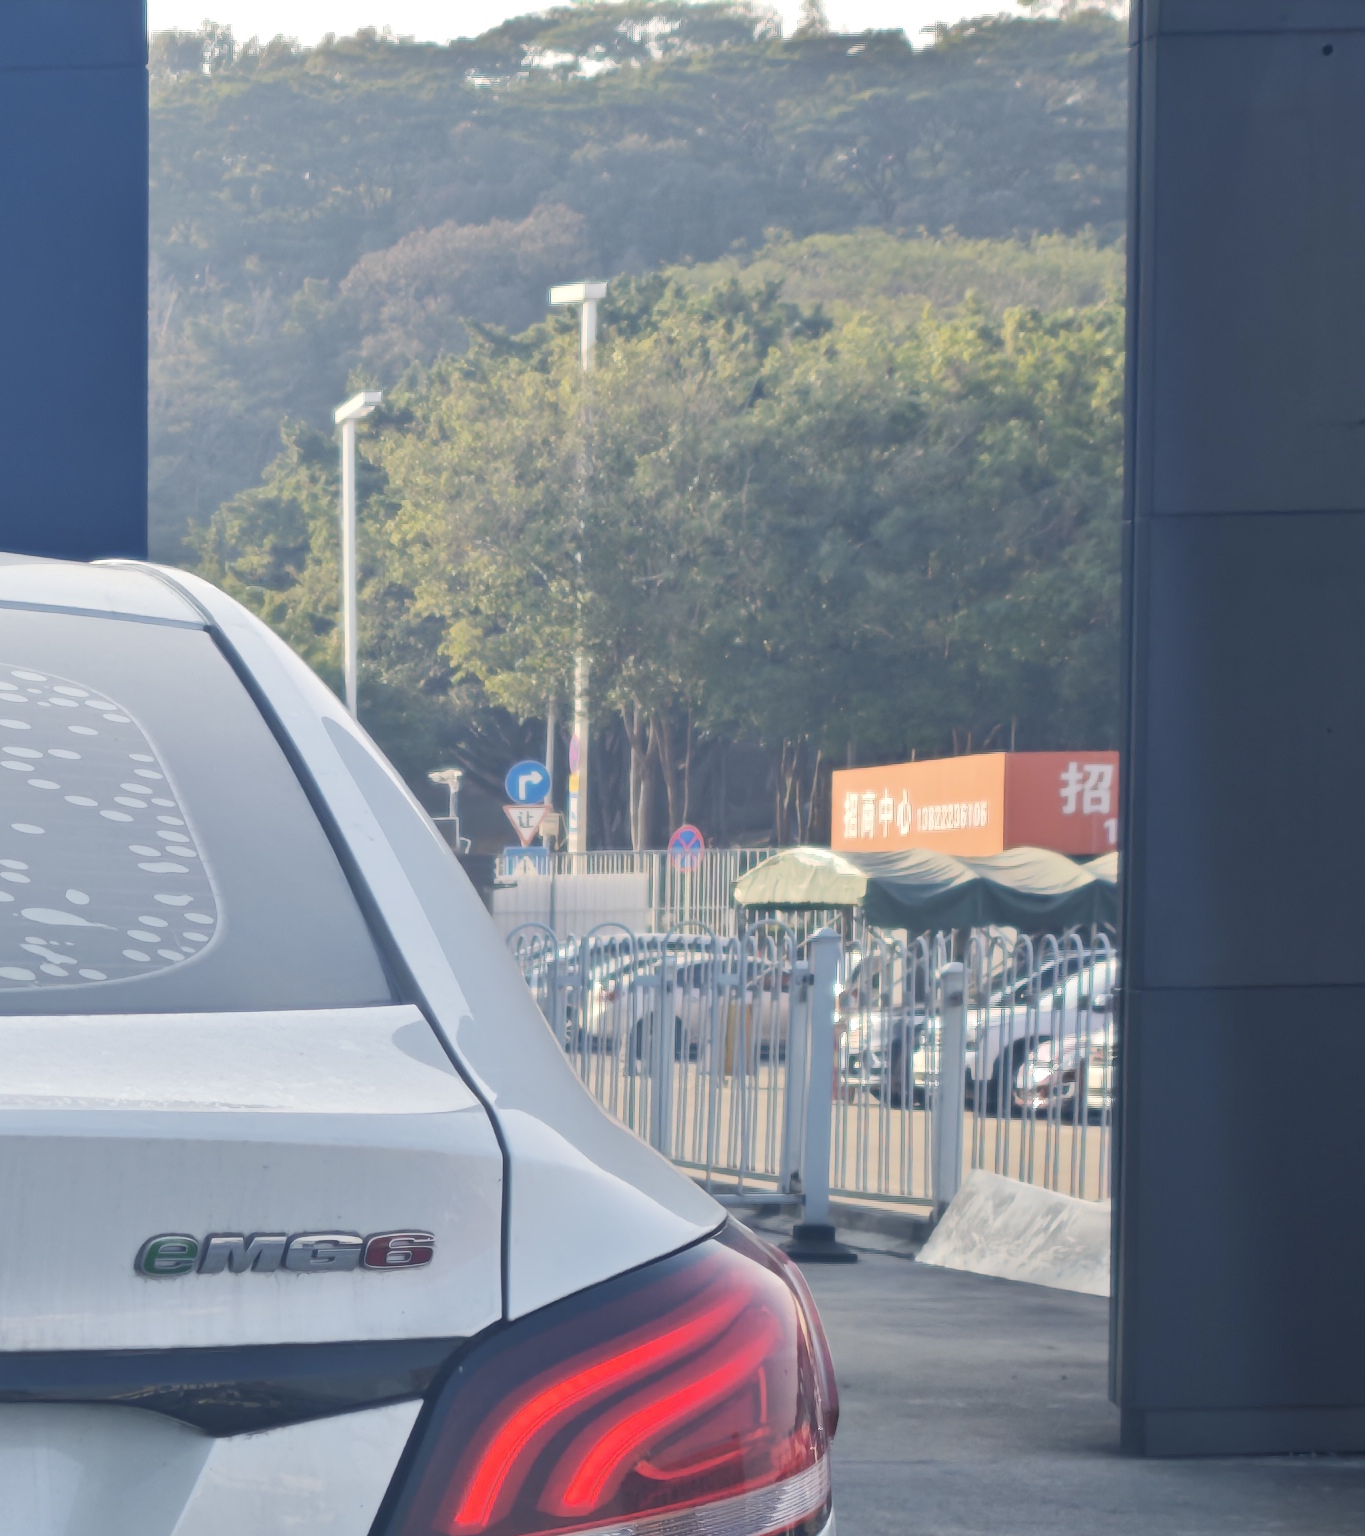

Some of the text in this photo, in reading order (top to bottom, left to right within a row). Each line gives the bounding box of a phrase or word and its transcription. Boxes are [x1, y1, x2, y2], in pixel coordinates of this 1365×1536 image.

[843, 787, 912, 839] 招商中心
[1059, 761, 1116, 815] 招
[517, 811, 534, 829] 让
